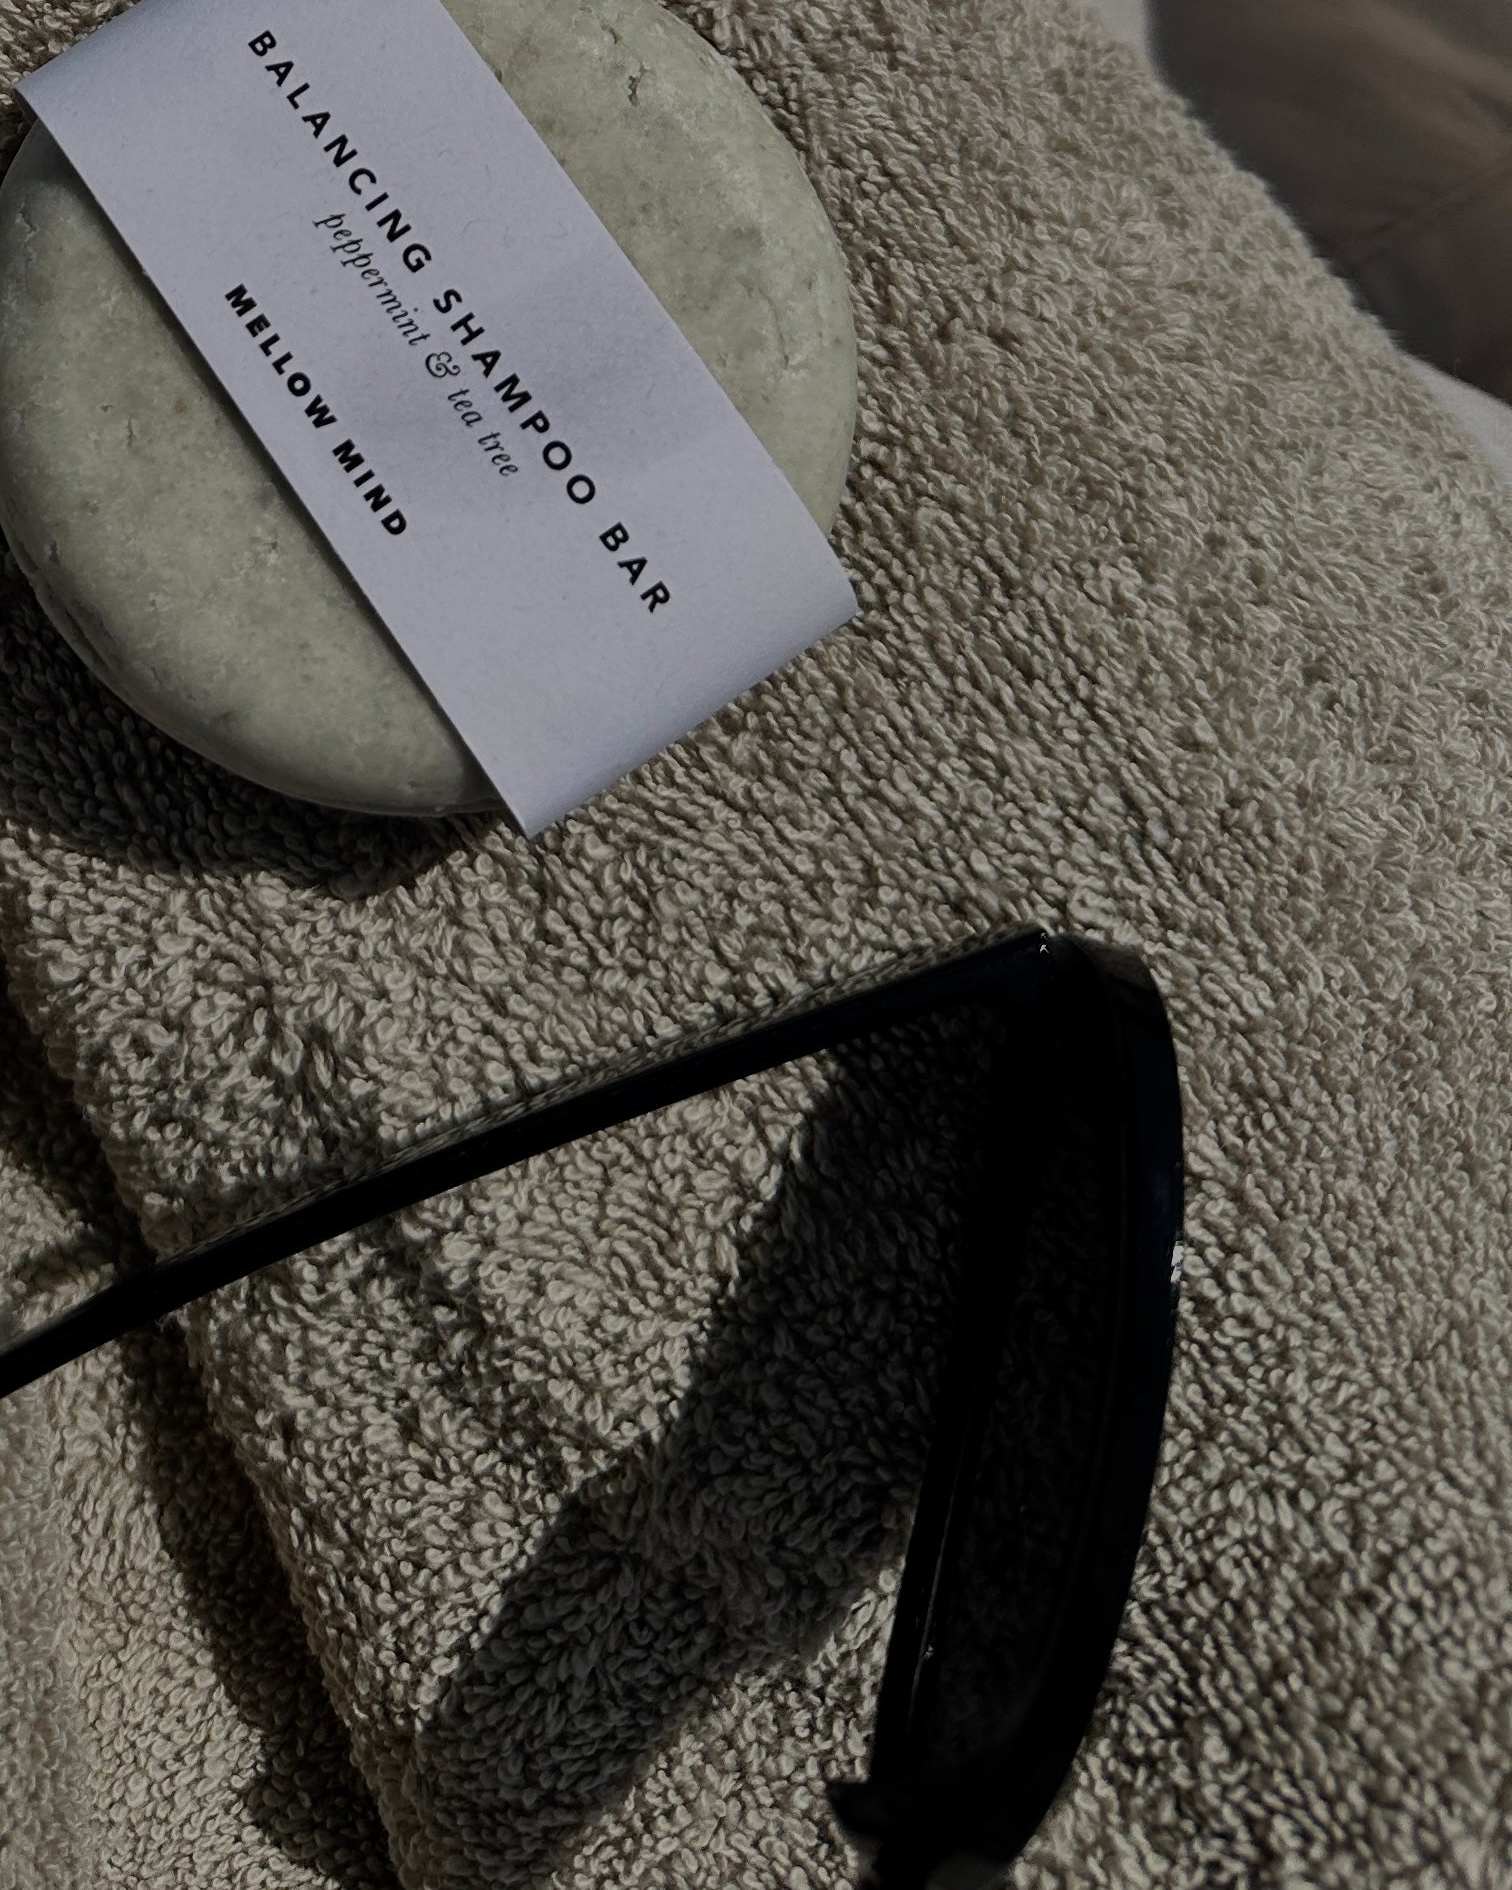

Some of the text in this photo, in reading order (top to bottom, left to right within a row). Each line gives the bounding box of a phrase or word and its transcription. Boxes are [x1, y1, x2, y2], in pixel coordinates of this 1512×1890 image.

[224, 283, 408, 536] MELLOW MIND
[248, 30, 671, 614] BALANCING SHAMPOO BAR
[314, 212, 519, 478] peppermint & tea tree
